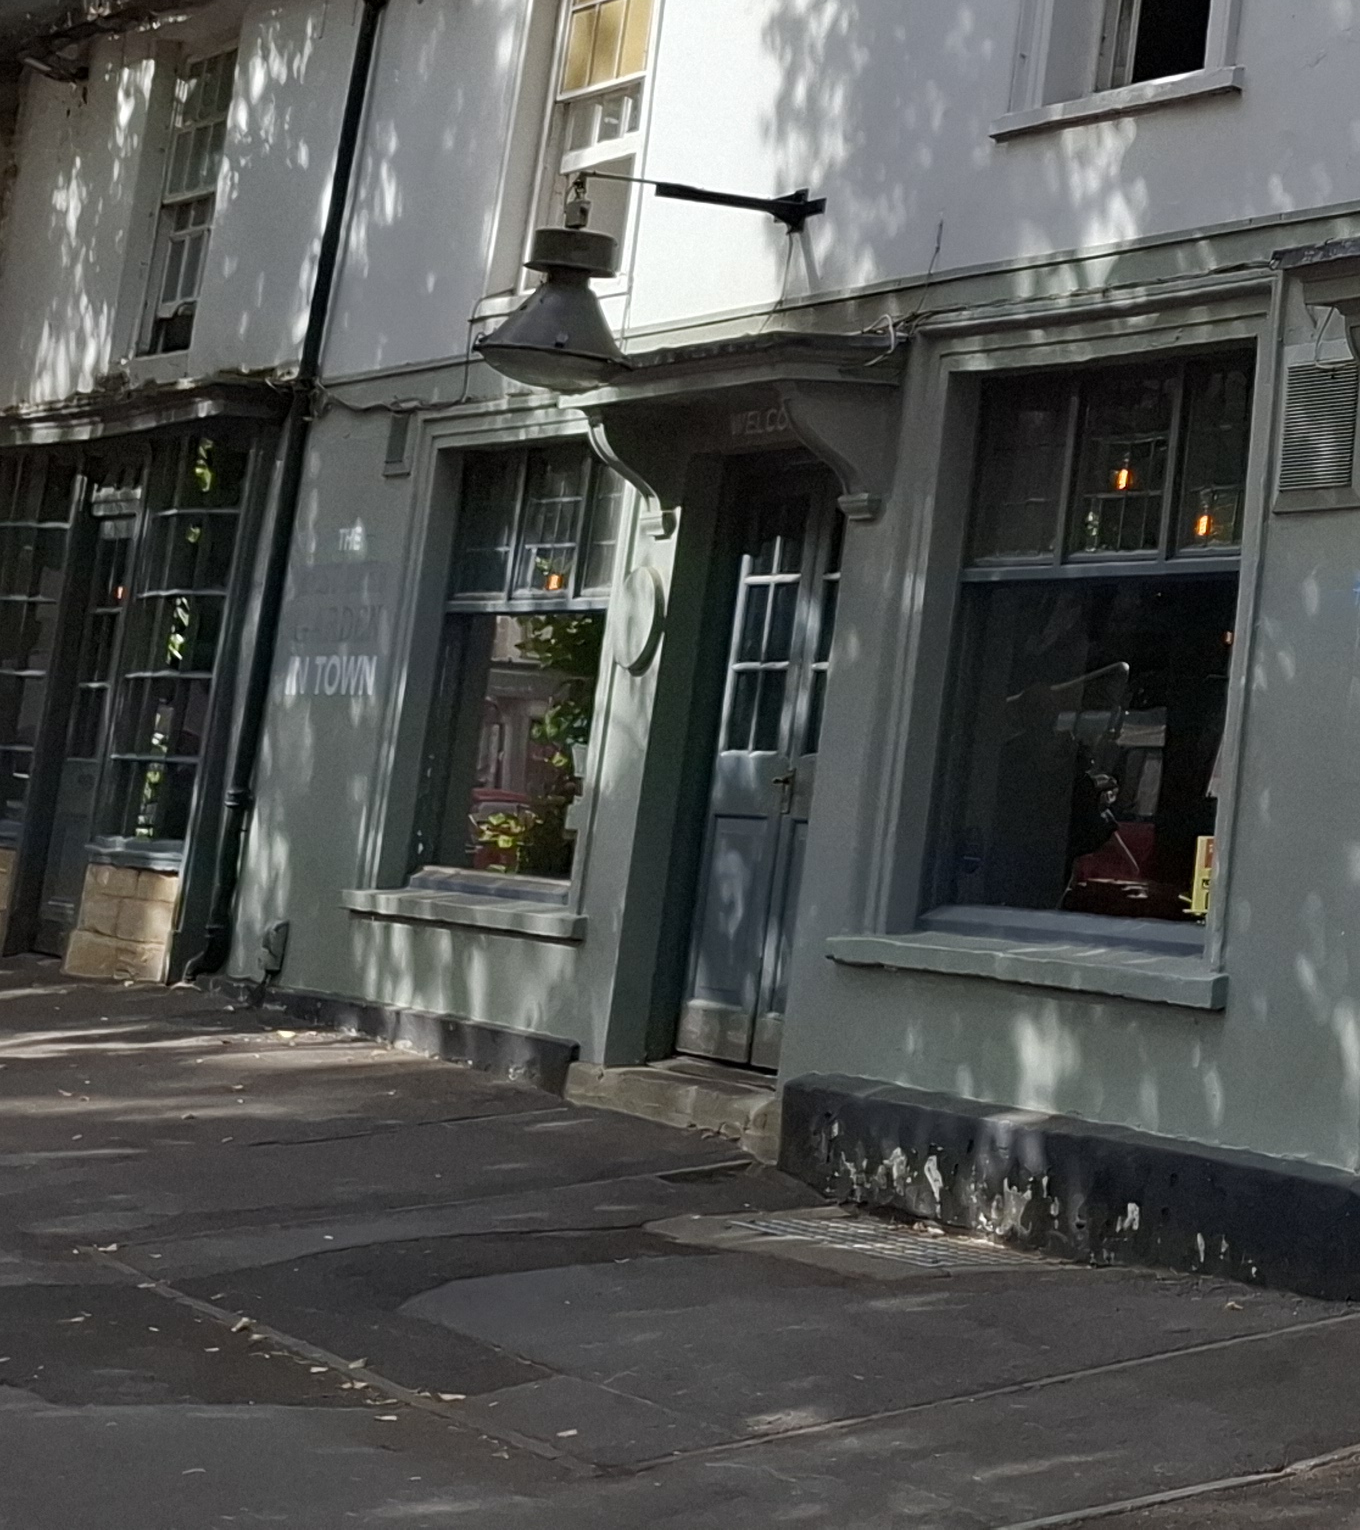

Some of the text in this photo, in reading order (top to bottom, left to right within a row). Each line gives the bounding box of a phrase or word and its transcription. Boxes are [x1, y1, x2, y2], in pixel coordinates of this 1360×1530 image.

[730, 407, 788, 436] WELCO
[338, 526, 362, 551] THE
[285, 654, 377, 696] IN TOWN
